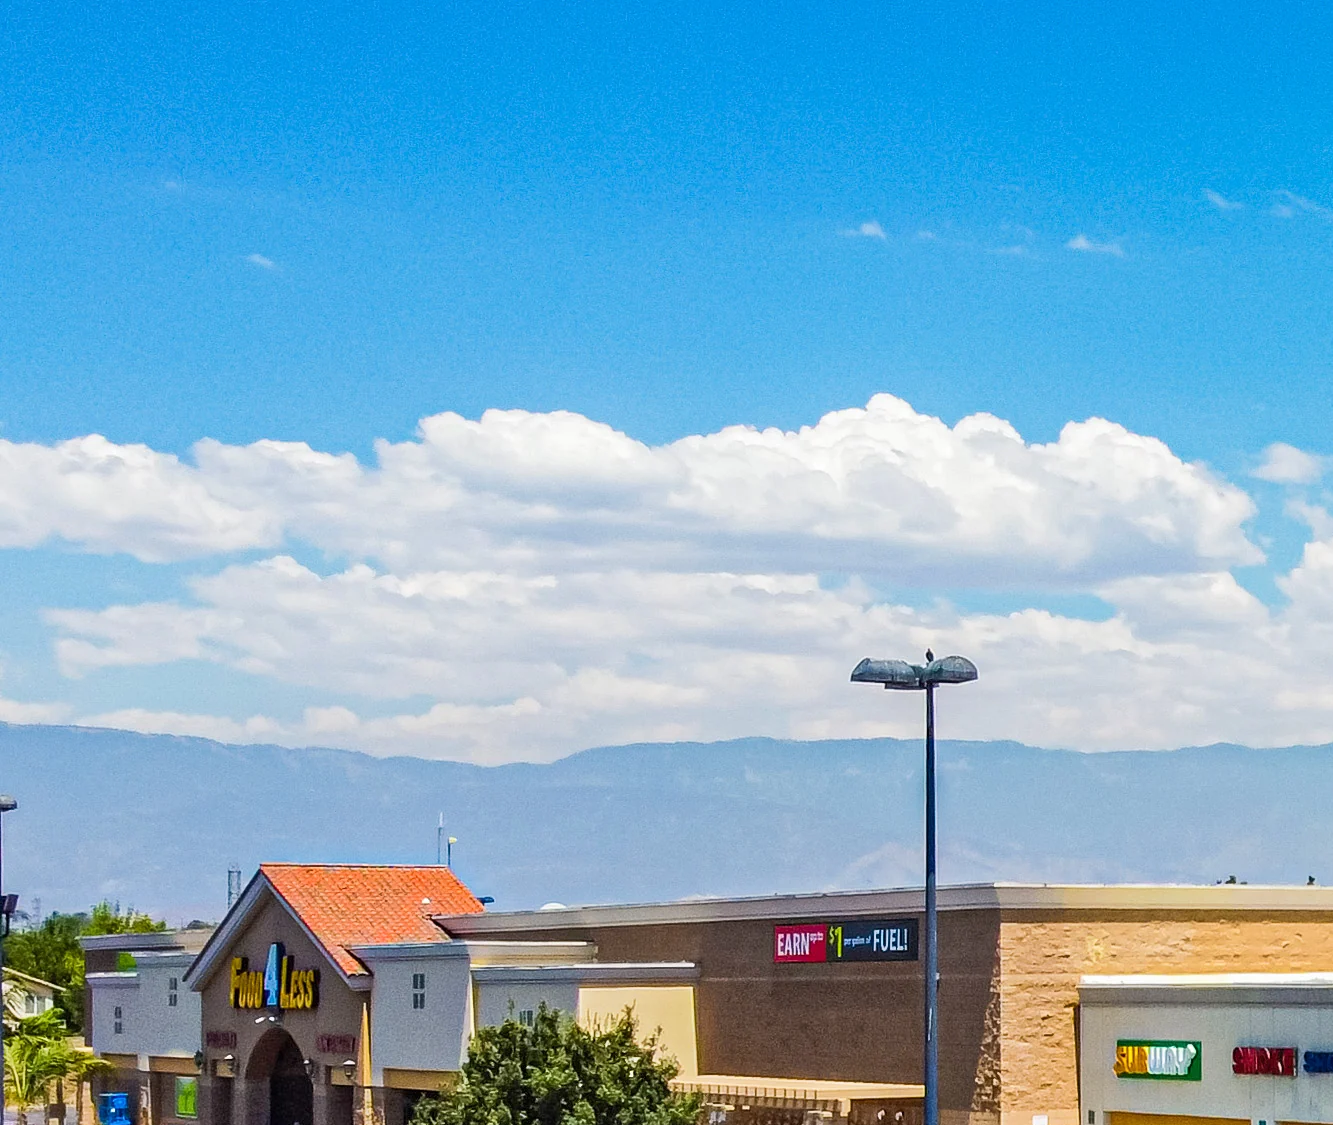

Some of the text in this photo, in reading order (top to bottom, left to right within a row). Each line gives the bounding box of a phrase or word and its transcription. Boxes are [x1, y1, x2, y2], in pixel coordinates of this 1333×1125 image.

[777, 932, 810, 956] EARN
[829, 926, 842, 957] $1
[873, 928, 908, 951] FUEL!
[263, 942, 279, 1006] 4
[1113, 1044, 1197, 1078] SUBWAY
